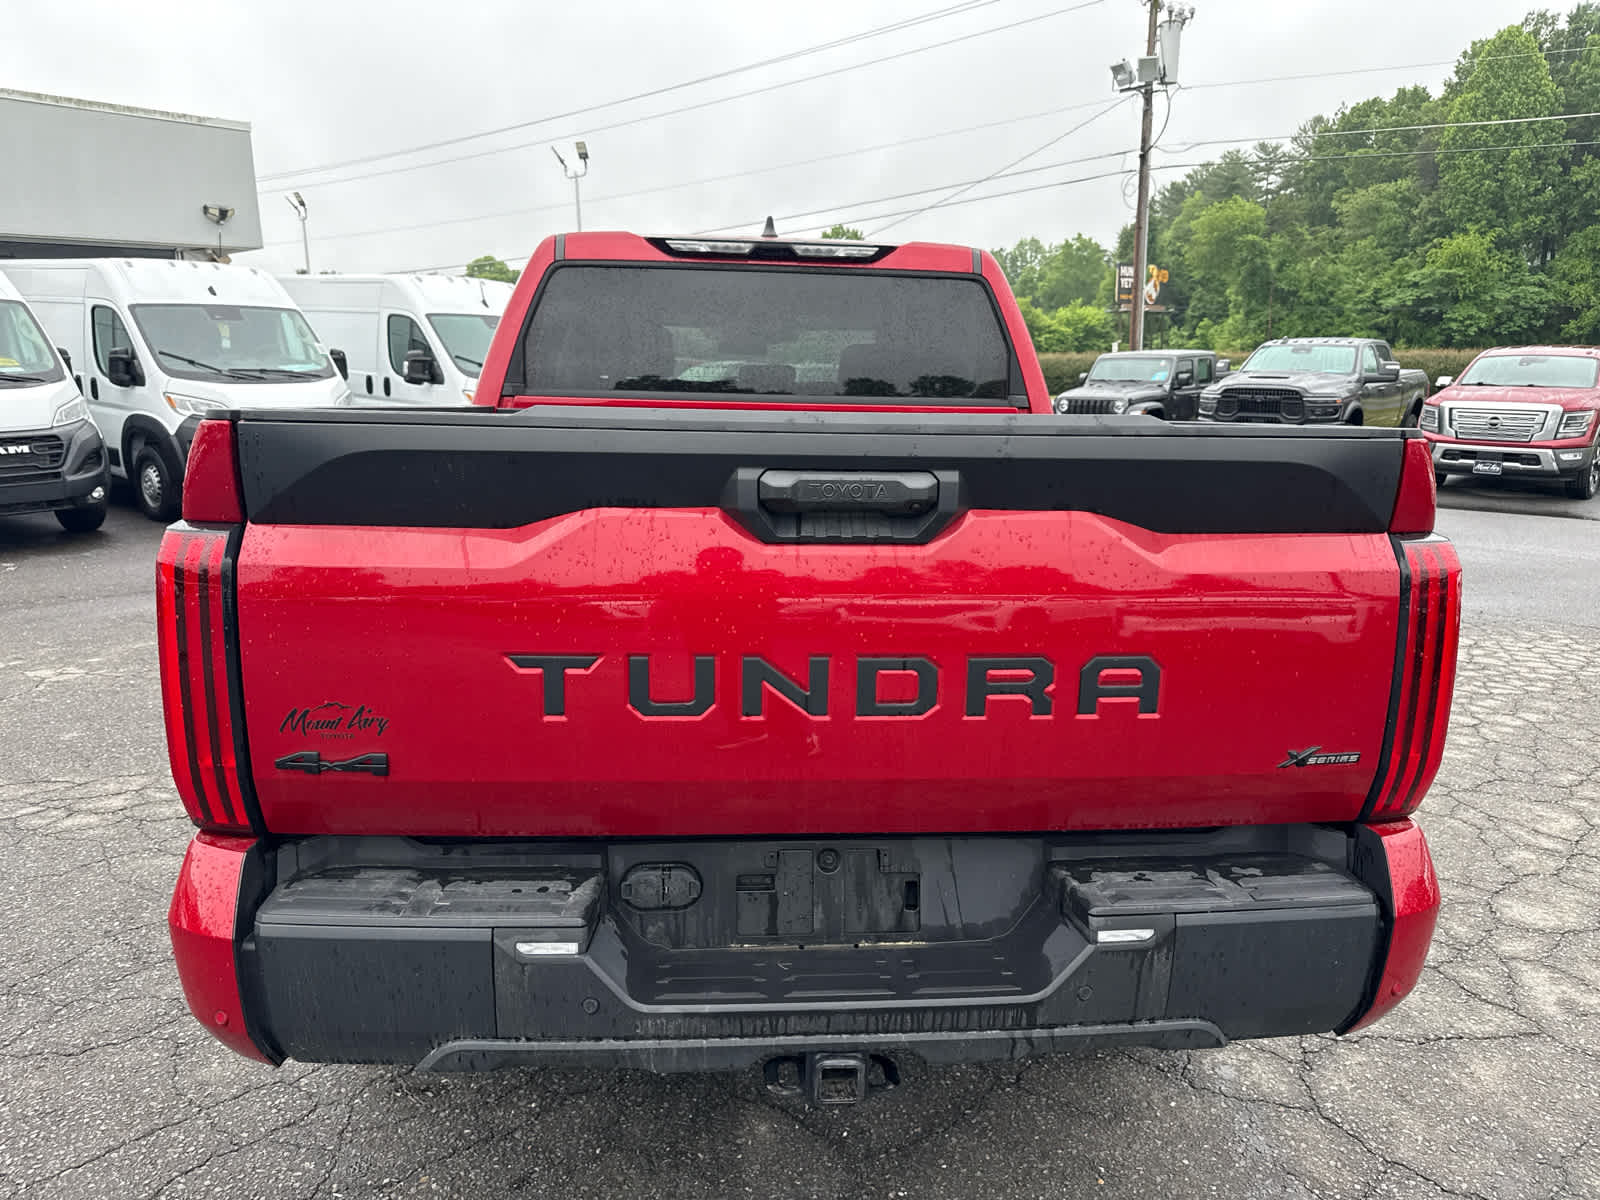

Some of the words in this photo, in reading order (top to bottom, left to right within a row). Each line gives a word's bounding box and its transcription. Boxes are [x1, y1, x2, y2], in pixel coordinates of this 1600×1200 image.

[0, 445, 30, 455] AM
[808, 483, 888, 498] TOYOTA
[502, 654, 1163, 722] TUNDRA
[279, 707, 344, 737] Mount
[347, 704, 391, 737] Airy
